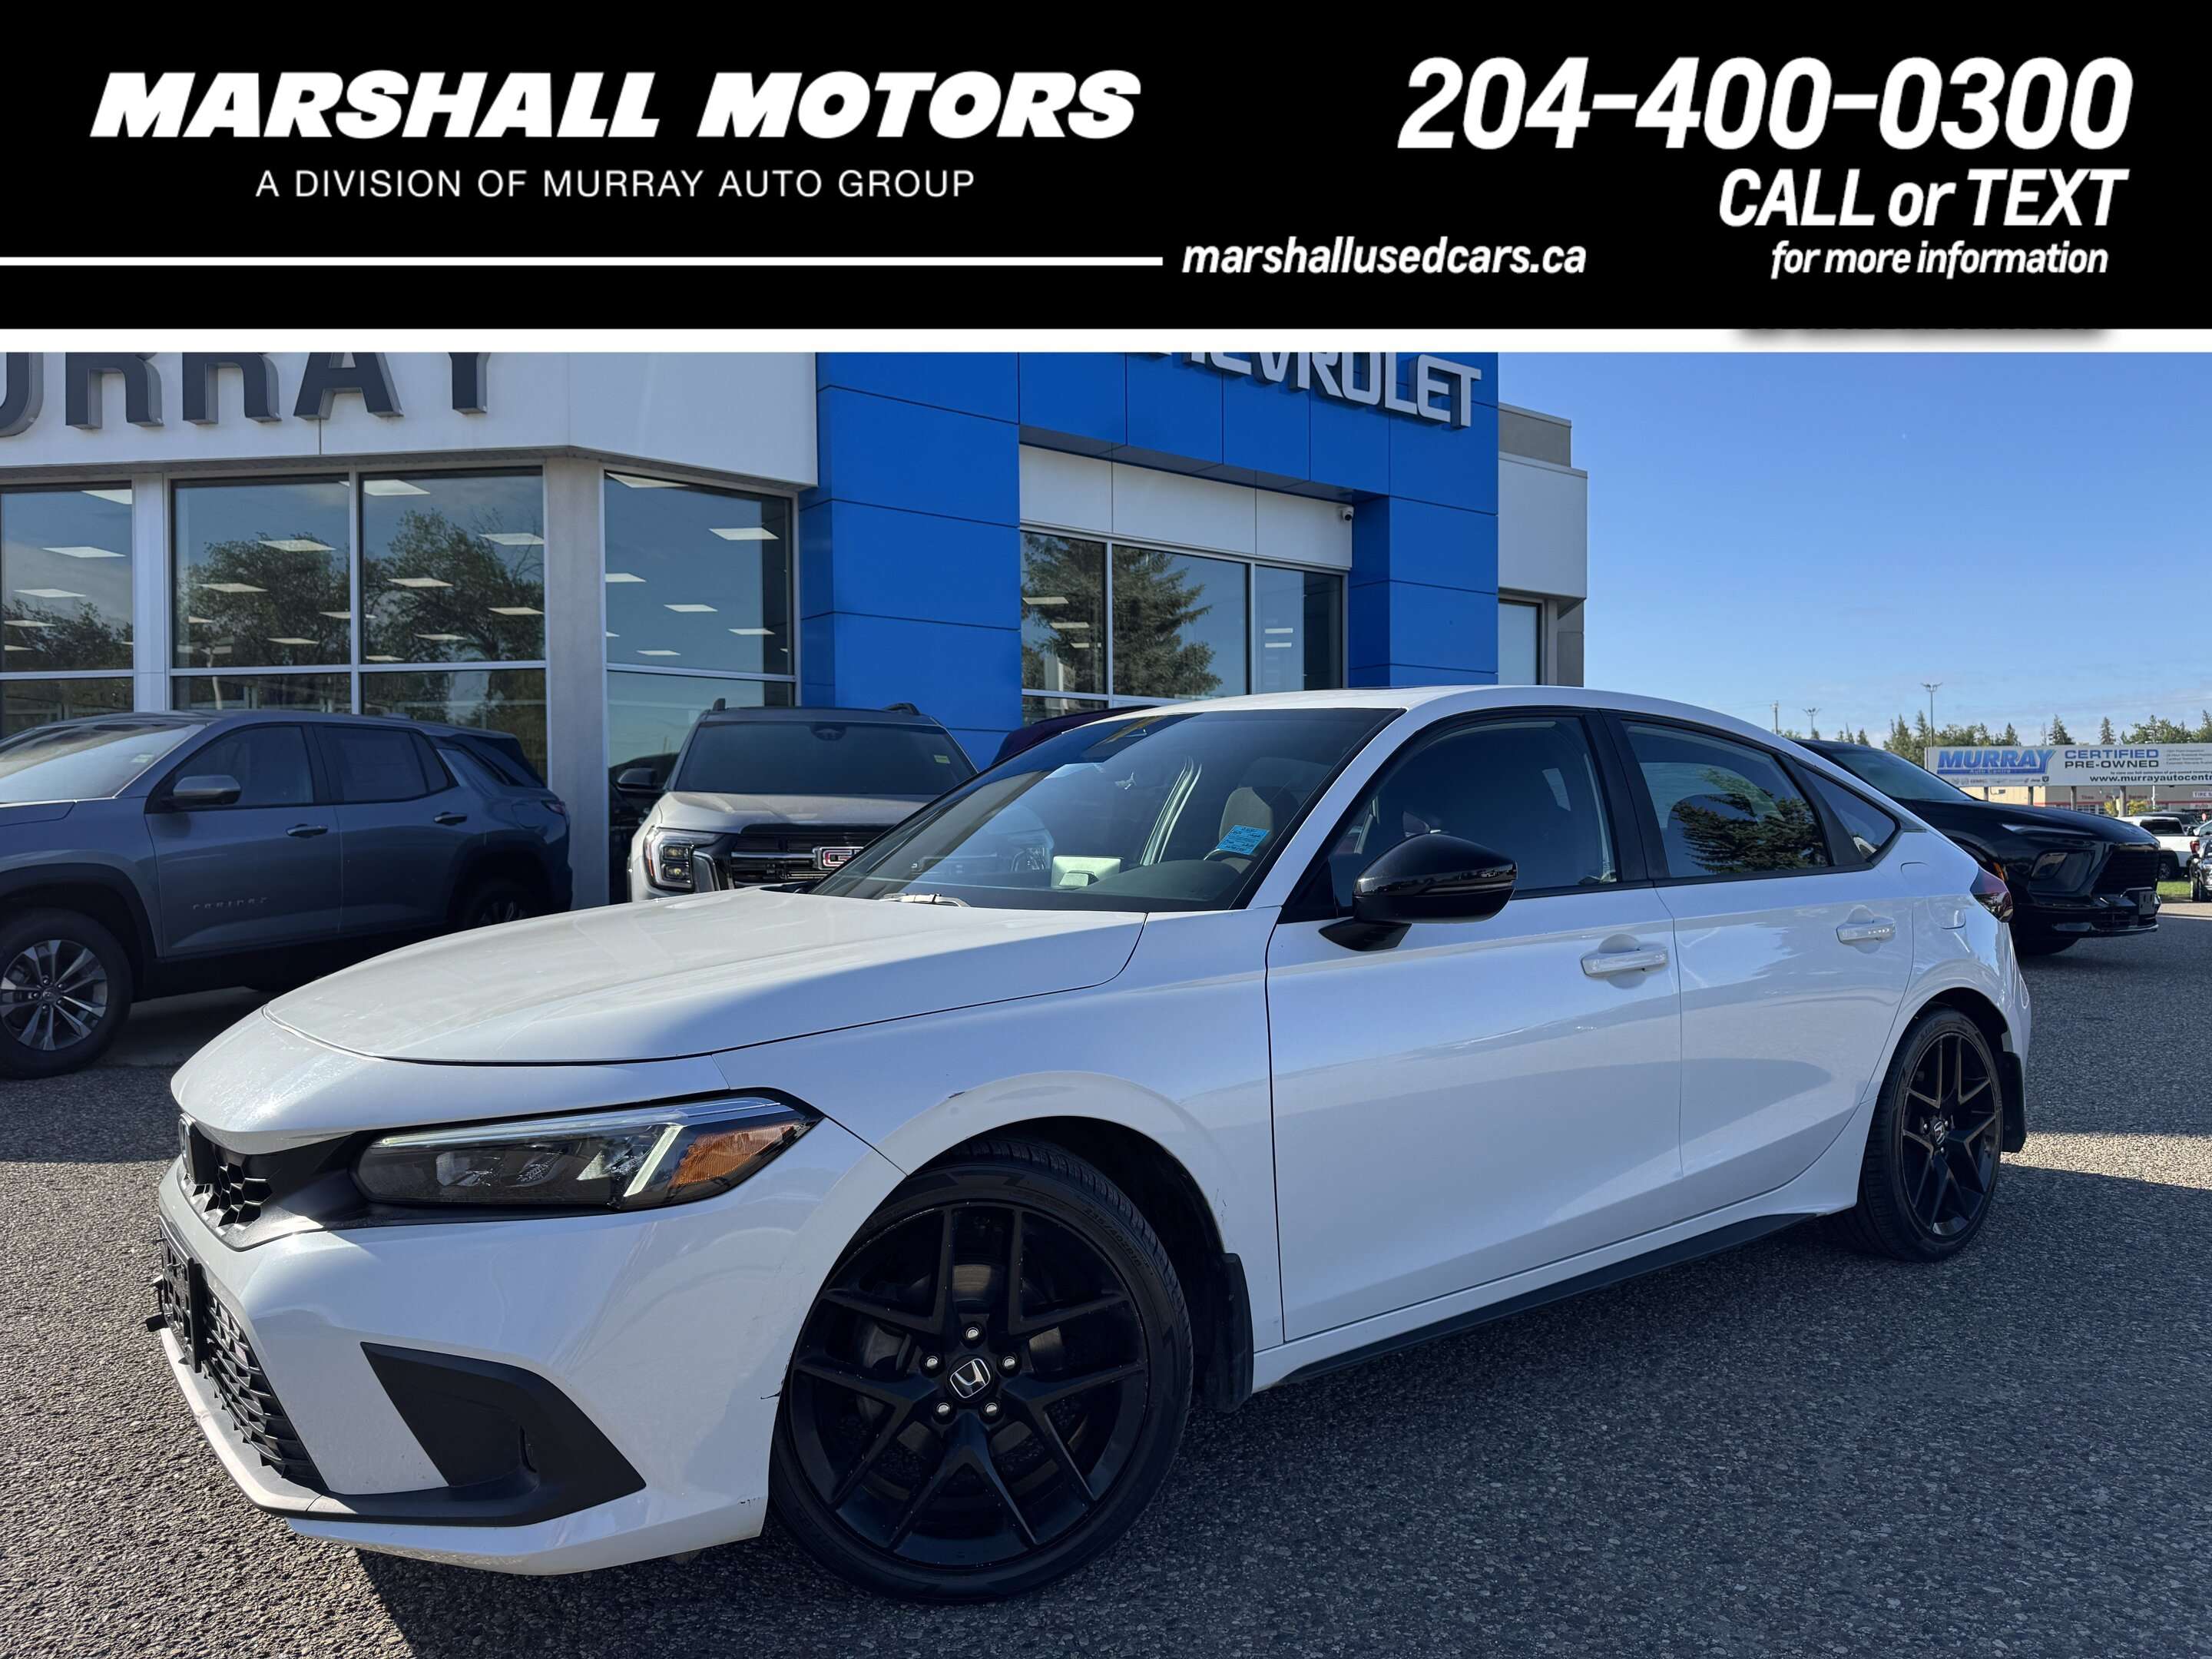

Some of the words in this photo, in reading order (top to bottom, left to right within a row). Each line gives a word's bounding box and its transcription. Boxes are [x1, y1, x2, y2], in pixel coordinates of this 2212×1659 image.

[1938, 749, 2056, 769] MURRAY
[2065, 749, 2159, 760] CERTIFIED
[2065, 760, 2159, 769] PRE-OWNED
